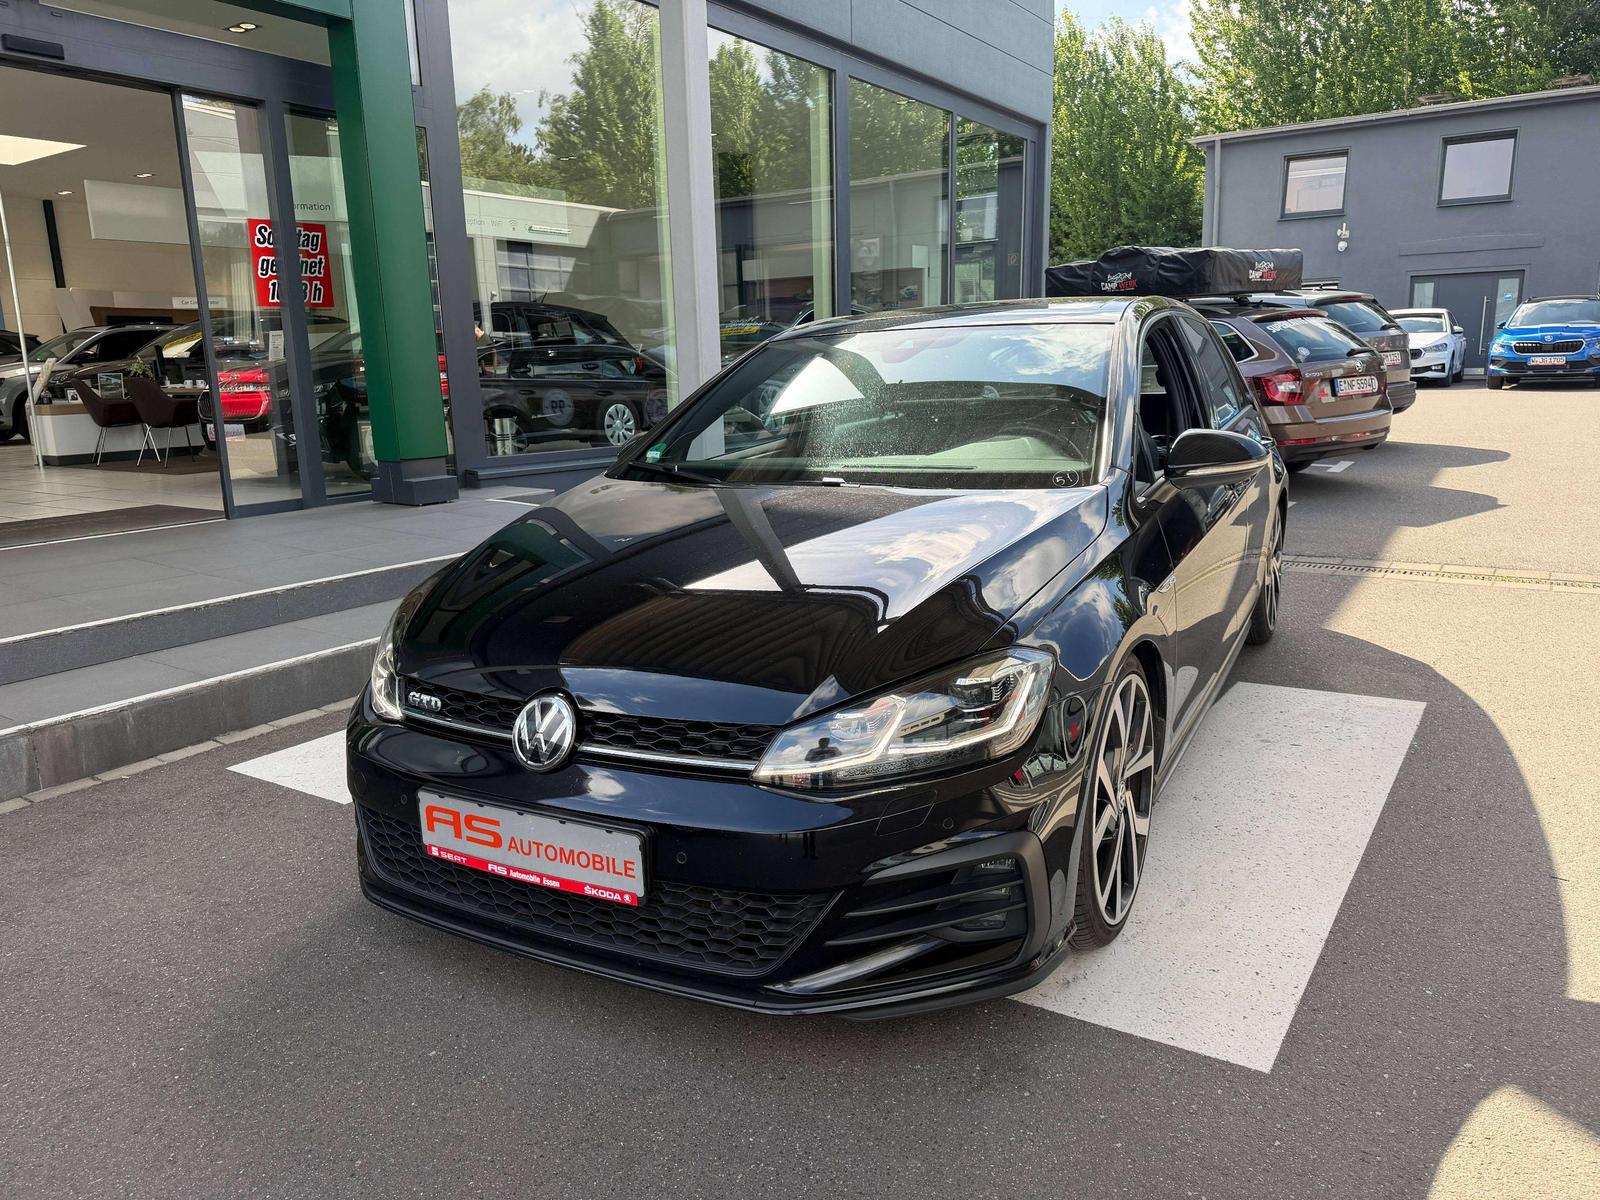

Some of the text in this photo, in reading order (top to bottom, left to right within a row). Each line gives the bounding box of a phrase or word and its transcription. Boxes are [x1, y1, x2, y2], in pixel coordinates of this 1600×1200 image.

[255, 224, 321, 253] Sotag
[258, 255, 325, 278] genet
[408, 691, 442, 711] GTD
[425, 804, 636, 879] AS AUTOMOBILE
[440, 851, 467, 864] SEAT
[487, 862, 560, 888] AS Automobile Essen
[583, 884, 622, 901] ŠKODA
